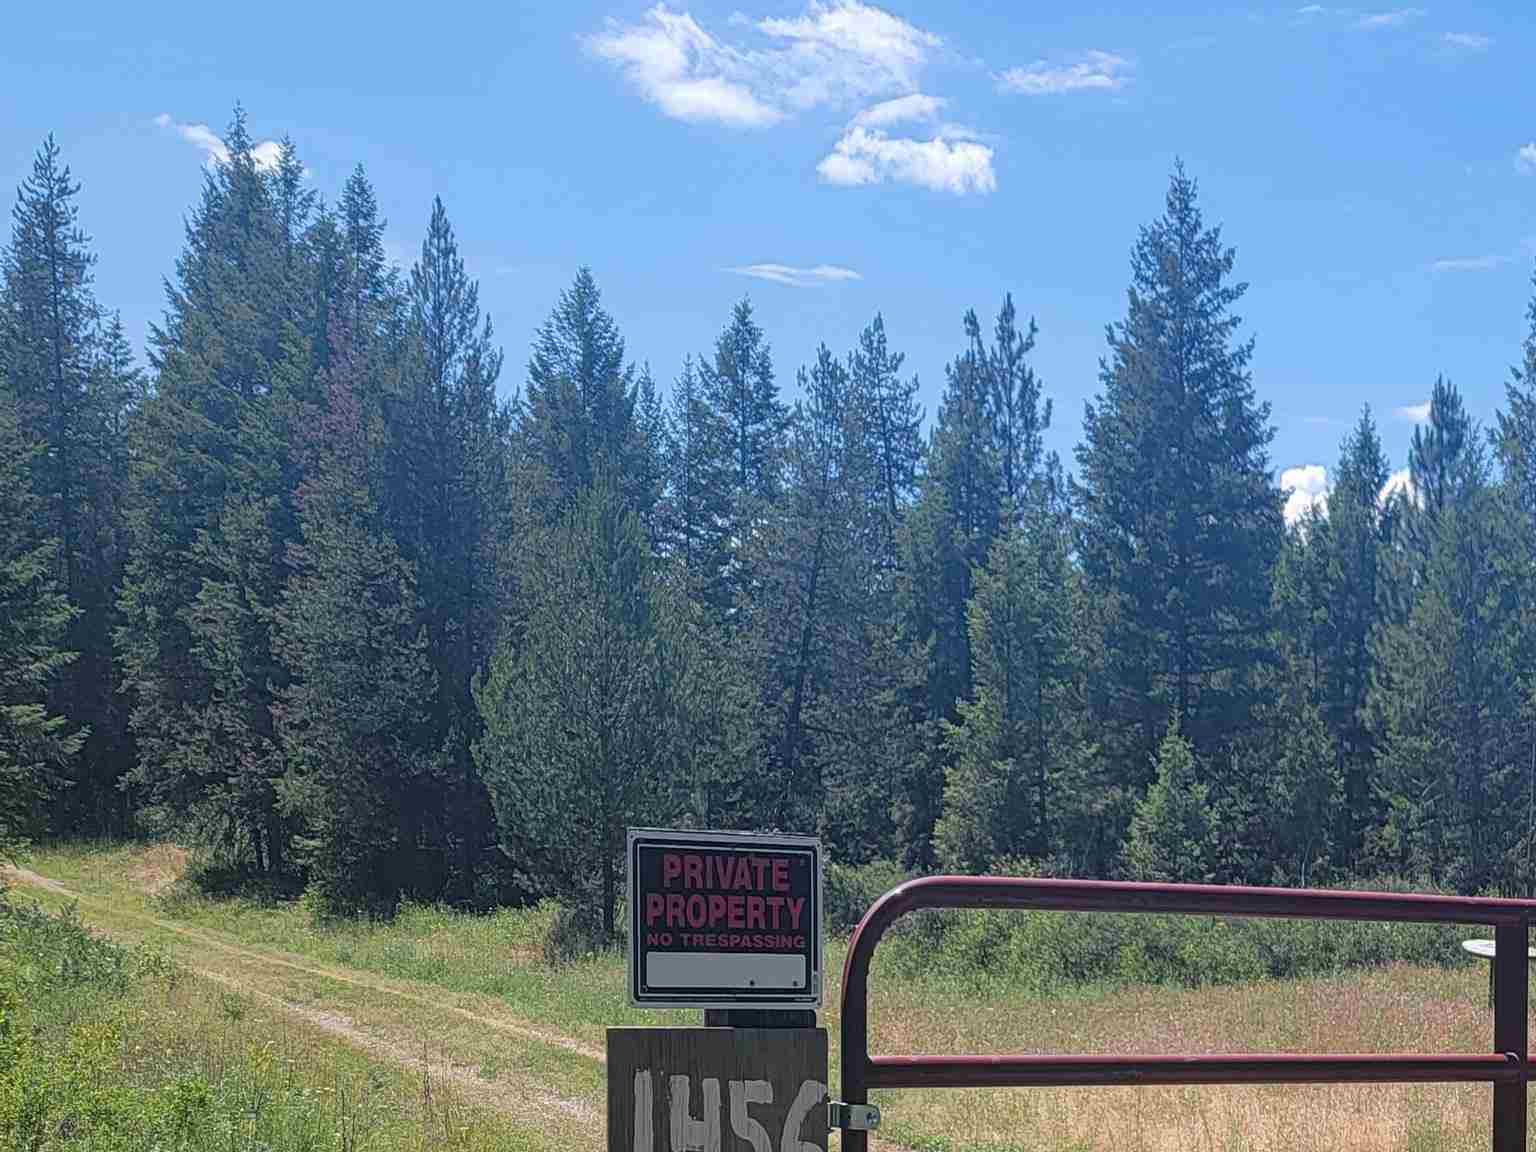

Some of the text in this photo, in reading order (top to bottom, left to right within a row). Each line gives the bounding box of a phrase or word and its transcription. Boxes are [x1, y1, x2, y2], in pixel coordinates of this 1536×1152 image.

[663, 854, 792, 892] PRIVATE
[645, 894, 806, 930] PROPERTY
[647, 933, 806, 949] NO TRESPASSING
